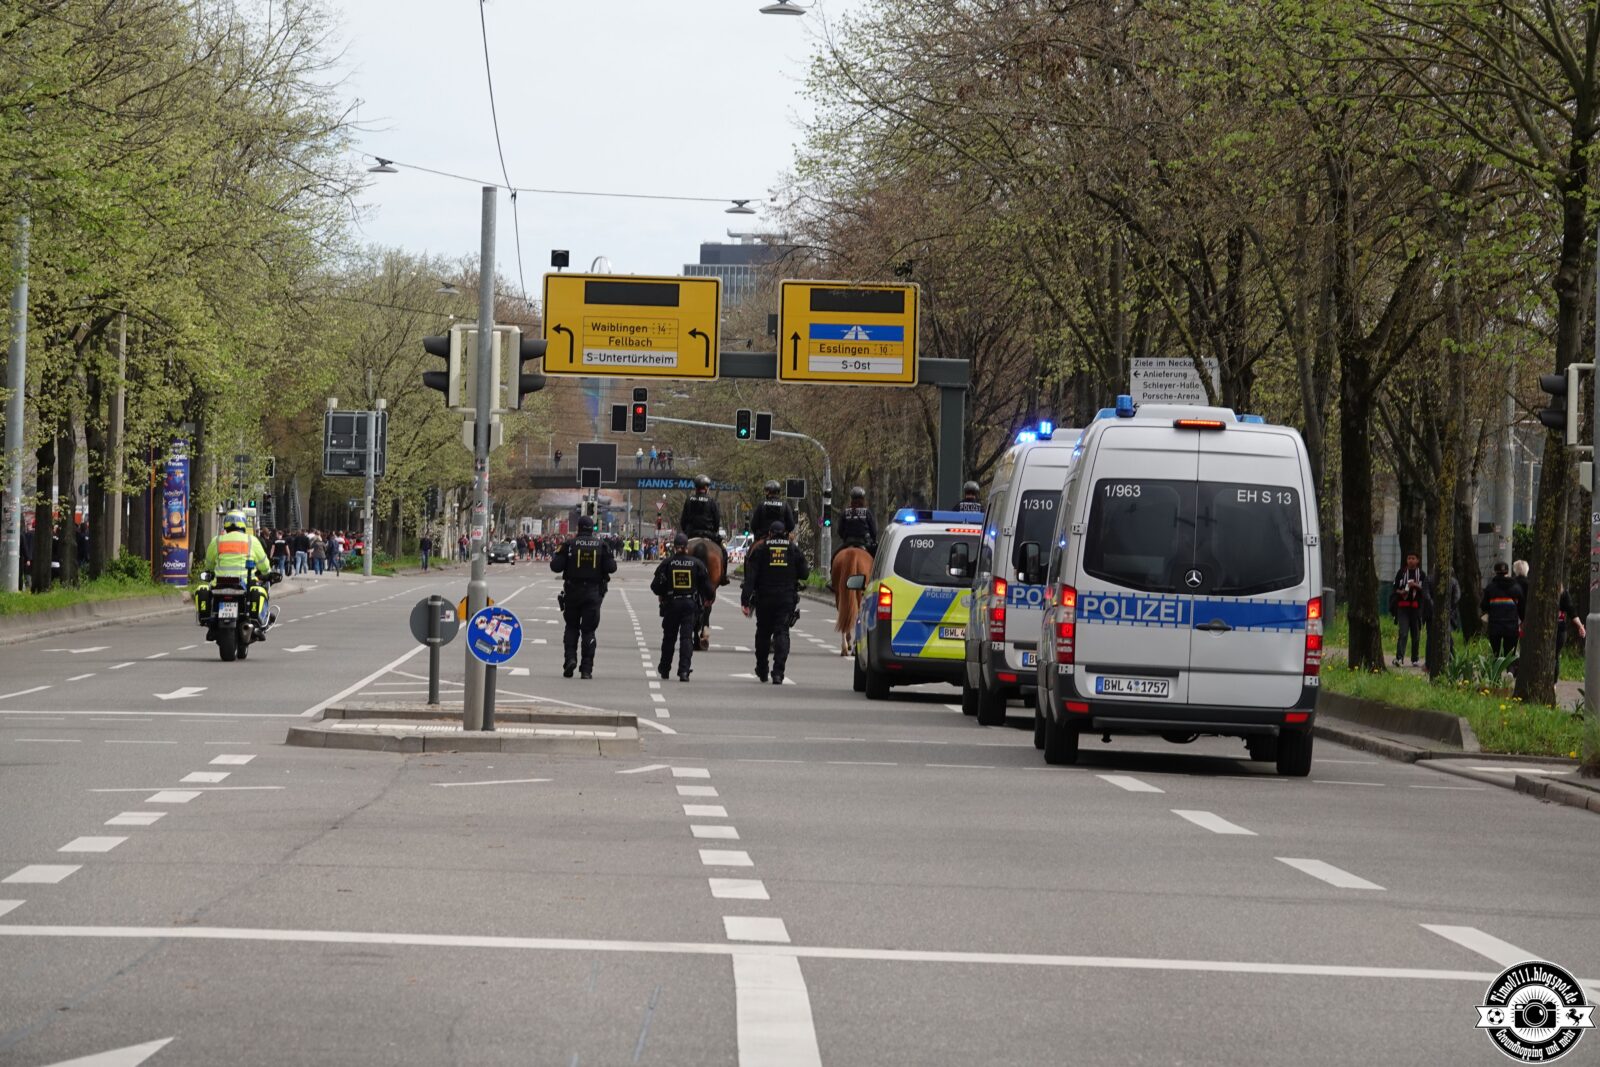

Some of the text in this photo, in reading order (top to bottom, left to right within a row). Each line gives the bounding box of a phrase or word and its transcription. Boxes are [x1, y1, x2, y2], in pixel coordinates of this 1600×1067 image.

[591, 322, 648, 335] Waiblingen
[608, 336, 653, 347] Fellbach
[819, 343, 870, 356] Esslingen
[586, 352, 674, 365] S-Untertürkheim
[1168, 360, 1213, 368] Neckarrk
[841, 360, 871, 371] S-Ost
[1143, 370, 1188, 379] Anlieferung
[1142, 381, 1200, 390] Schleyer-Halle
[1142, 392, 1200, 400] Porsche-Arena
[1104, 485, 1141, 498] 1/963
[1237, 490, 1292, 505] EH S 13
[1023, 499, 1053, 511] 1/310
[909, 538, 935, 549] 1/960
[670, 559, 695, 567] POLIZEI
[926, 591, 953, 600] POLIZEI
[1012, 587, 1043, 606] PO
[1082, 597, 1183, 623] POLIZEI
[944, 628, 959, 638] BWL
[1103, 679, 1167, 695] BWL 4 1757
